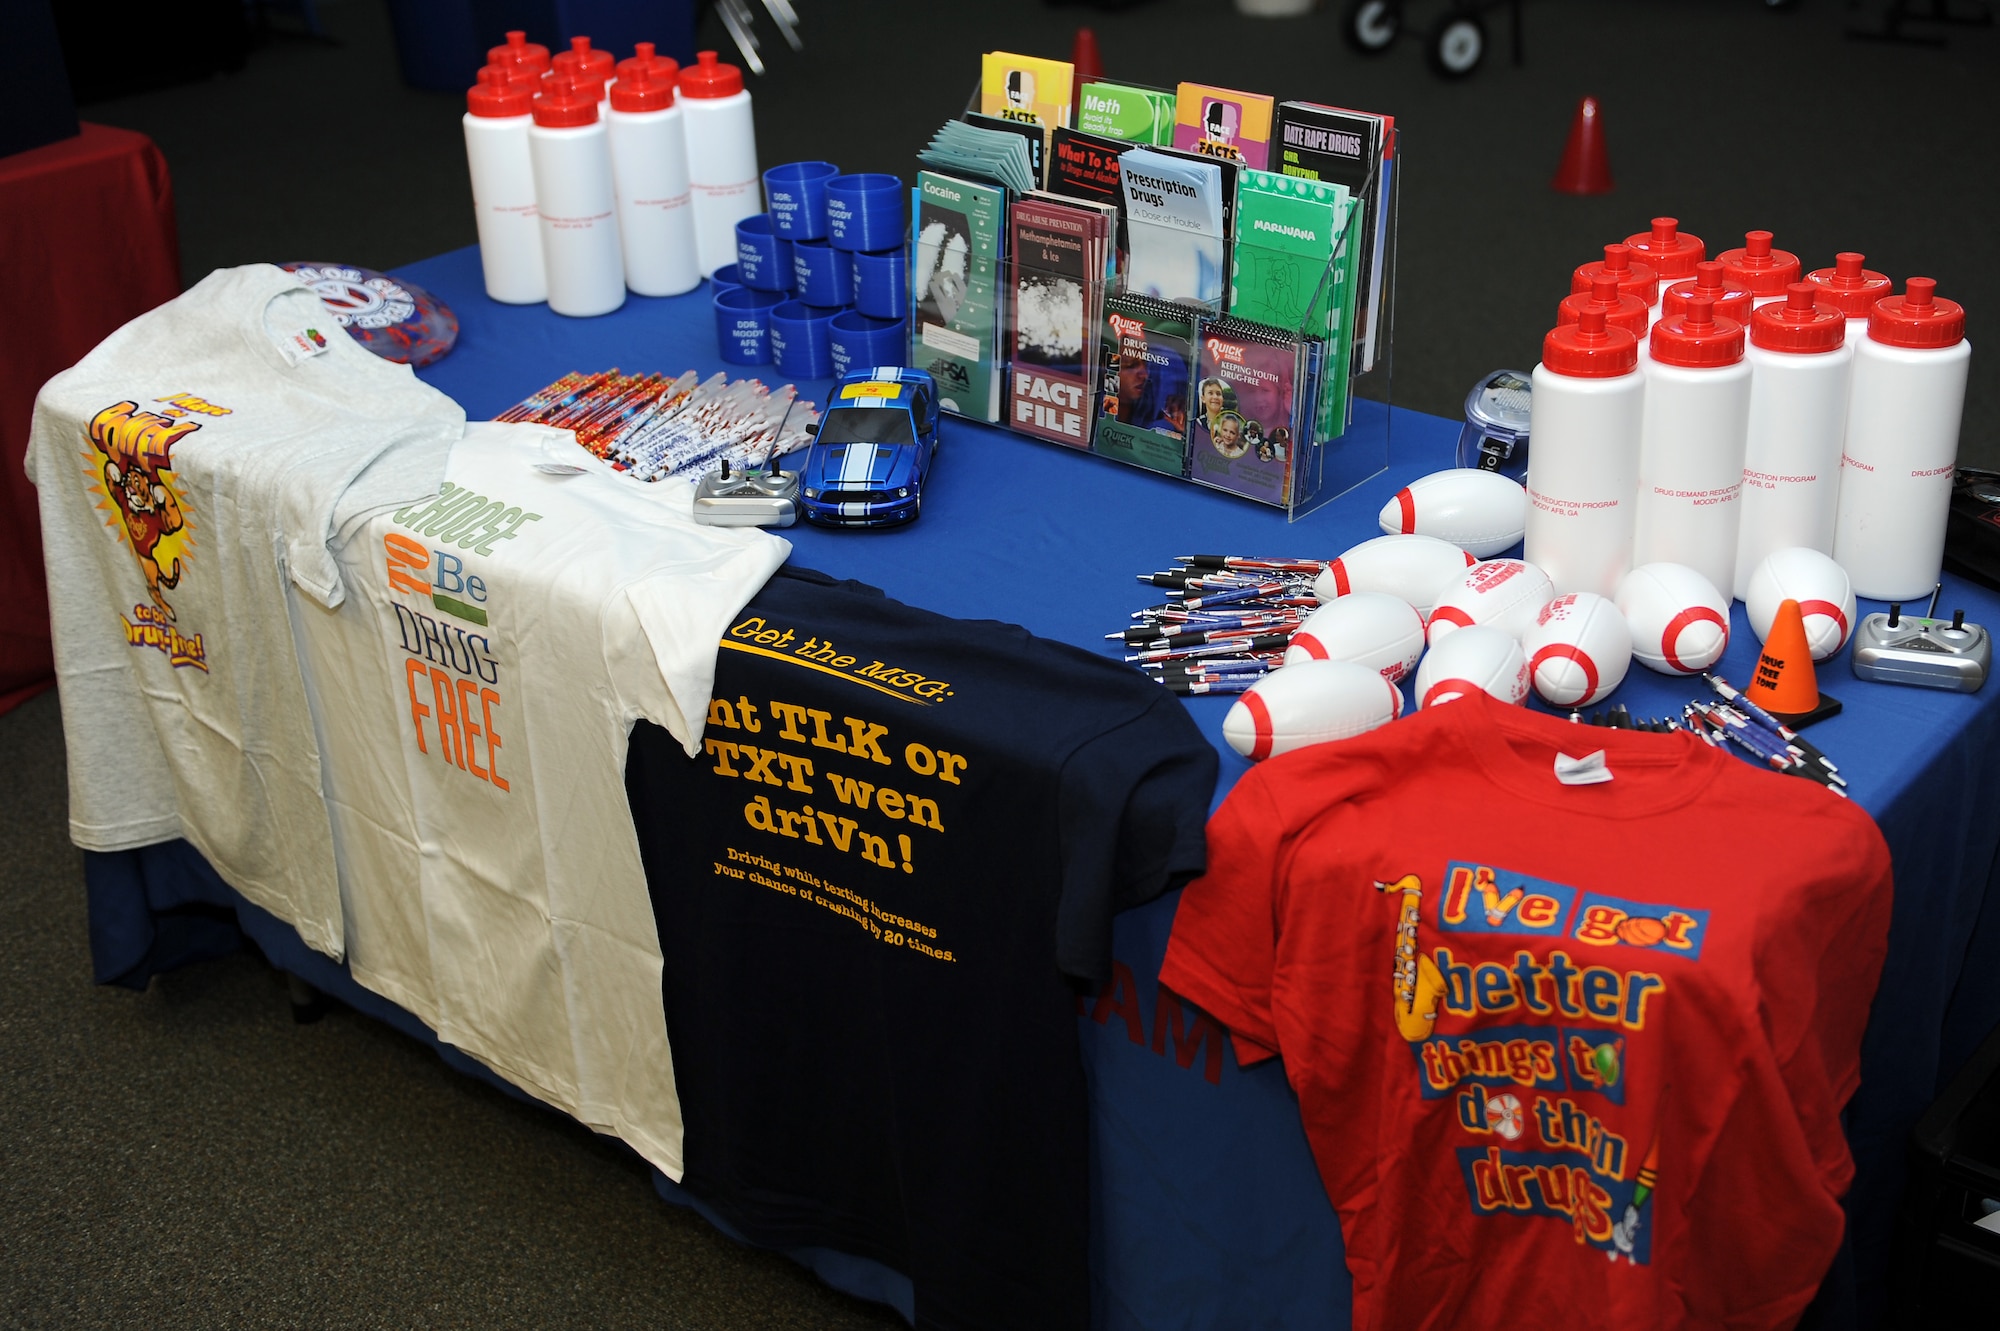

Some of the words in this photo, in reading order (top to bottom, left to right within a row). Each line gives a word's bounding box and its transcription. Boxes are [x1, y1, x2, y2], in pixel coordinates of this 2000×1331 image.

[1084, 94, 1121, 116] Meth
[1002, 109, 1037, 124] FACTS
[1083, 112, 1103, 124] Avoid
[1104, 116, 1113, 125] its
[1082, 120, 1108, 135] deadly
[1108, 125, 1124, 137] trap
[1209, 122, 1231, 136] FACE
[1199, 141, 1238, 160] FACTS
[1284, 124, 1304, 144] DATE
[1304, 129, 1327, 149] RAPE
[1328, 133, 1361, 156] DRUGS
[1057, 142, 1086, 164] What
[1088, 151, 1102, 168] To
[1105, 157, 1119, 171] Sa
[1066, 163, 1083, 178] Drugs
[1084, 169, 1096, 179] and
[1096, 168, 1119, 185] Alcohol
[1126, 169, 1197, 199] Prescription
[924, 181, 962, 202] Cocaine
[1130, 186, 1164, 208] Drugs
[771, 202, 799, 211] MOODY
[827, 208, 852, 220] MOODY
[780, 221, 791, 229] GA
[1016, 211, 1031, 222] DRUG
[1031, 214, 1048, 226] ABUSE
[1048, 218, 1083, 233] PREVENTION
[1133, 208, 1142, 217] A
[1143, 209, 1162, 223] Dose
[1163, 212, 1172, 224] of
[1172, 214, 1201, 230] Trouble
[834, 229, 845, 238] GA
[1019, 228, 1082, 252] Methamphetamine
[1253, 219, 1316, 242] MARIJUANA
[1042, 249, 1049, 261] &
[1049, 250, 1060, 263] Ice
[732, 329, 765, 338] MOODY
[736, 320, 758, 329] DDR:
[1109, 314, 1144, 337] QUICK
[740, 339, 759, 348] AFB,
[743, 348, 756, 356] GA
[1123, 337, 1148, 351] DRUG
[1207, 338, 1244, 361] QUICK
[1122, 348, 1170, 367] AWARENESS
[941, 358, 970, 385] PSA
[1220, 369, 1261, 387] DRUG-FREE
[1221, 361, 1252, 376] KEEPING
[1252, 368, 1280, 383] YOUTH
[1015, 372, 1083, 410] FACT
[1016, 399, 1083, 438] FILE
[89, 400, 203, 474] POWER
[1743, 468, 1779, 482] EDUCTION
[1779, 475, 1817, 483] PROGRAM
[1749, 479, 1764, 489] AFB,
[1764, 482, 1776, 490] GA
[1911, 469, 1932, 478] DRUG
[1541, 495, 1581, 509] REDUCTION
[1582, 500, 1619, 510] PROGRAM
[1654, 486, 1674, 498] DRUG
[1675, 490, 1708, 498] DEMAND
[1693, 497, 1720, 506] MOODY
[392, 481, 544, 557] CHOOSE
[1551, 507, 1566, 516] AFB,
[1567, 509, 1578, 517] GA
[433, 550, 488, 602] Be
[133, 603, 153, 622] to
[391, 600, 500, 685] DRUG
[731, 616, 795, 650] Get
[794, 636, 857, 669] the
[853, 660, 955, 704] MSG:
[1761, 653, 1785, 669] DRUG
[1756, 675, 1778, 691] ZONE
[1759, 665, 1780, 680] FREE
[405, 658, 511, 794] FREE
[707, 695, 762, 734] nt
[769, 700, 892, 766] TLK
[904, 742, 968, 786] or
[704, 738, 815, 795] TXT
[826, 772, 945, 833] wen
[744, 795, 914, 875] driVn!
[726, 847, 782, 877] Driving
[783, 864, 821, 889] while
[823, 879, 871, 915] texting
[870, 901, 938, 939] increases
[713, 860, 747, 881] your
[749, 871, 797, 896] chance
[800, 888, 813, 901] of
[815, 892, 870, 932] crashing
[869, 921, 882, 940] by
[884, 929, 905, 948] 20
[906, 935, 958, 963] times.
[1442, 866, 1561, 928] I've
[1574, 905, 1699, 949] got
[1432, 946, 1666, 1032] better
[1076, 959, 1224, 1087] AM
[1420, 1038, 1557, 1091] things
[1568, 1036, 1626, 1090] to
[1457, 1083, 1525, 1142] do
[1471, 1146, 1615, 1245] drugs
